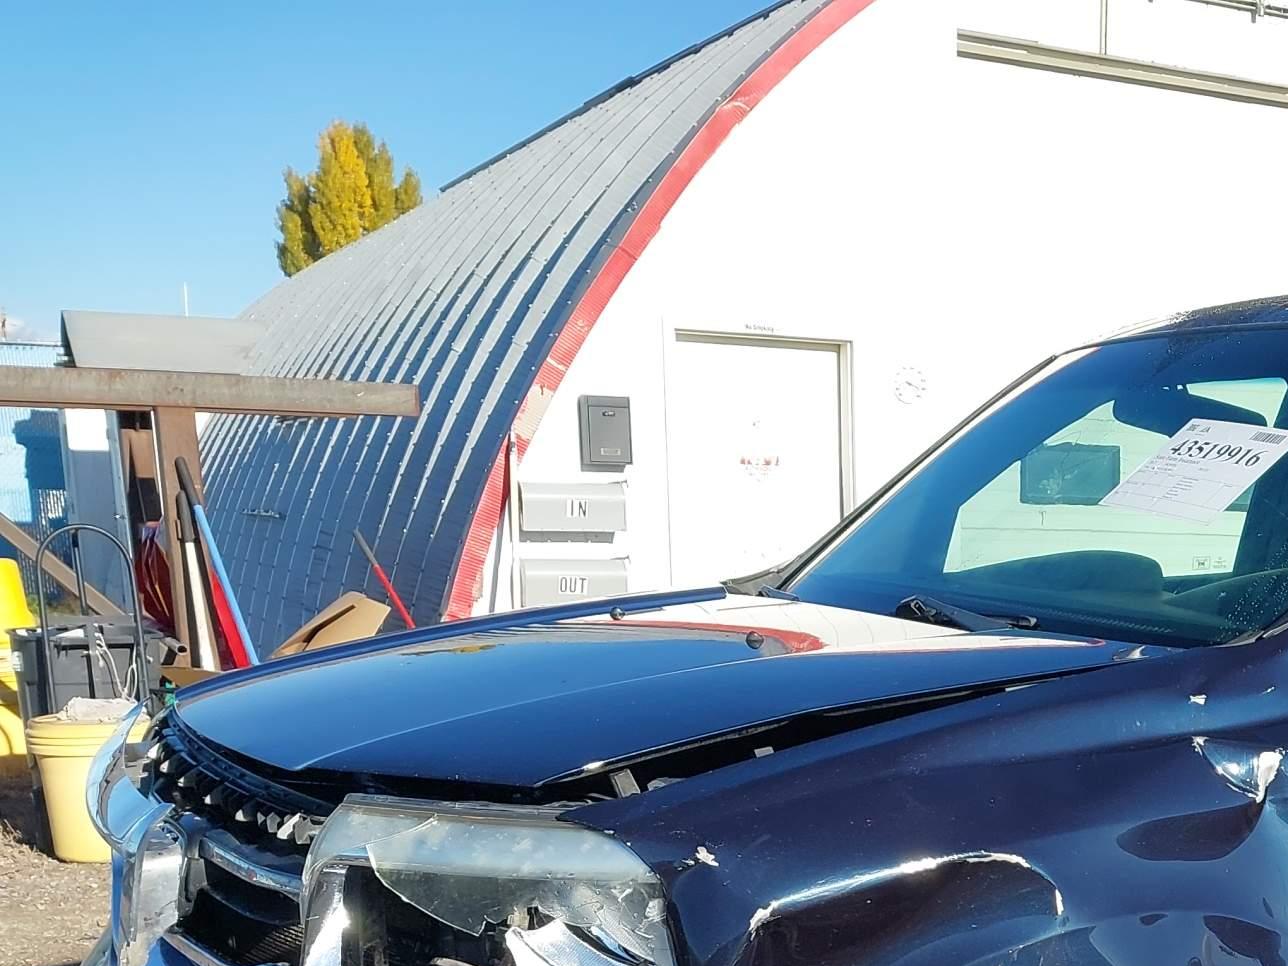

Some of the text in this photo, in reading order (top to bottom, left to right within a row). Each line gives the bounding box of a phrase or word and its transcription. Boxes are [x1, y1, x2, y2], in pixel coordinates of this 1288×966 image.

[1170, 439, 1269, 467] 43519916
[570, 499, 588, 518] IN
[559, 577, 587, 594] OUT
